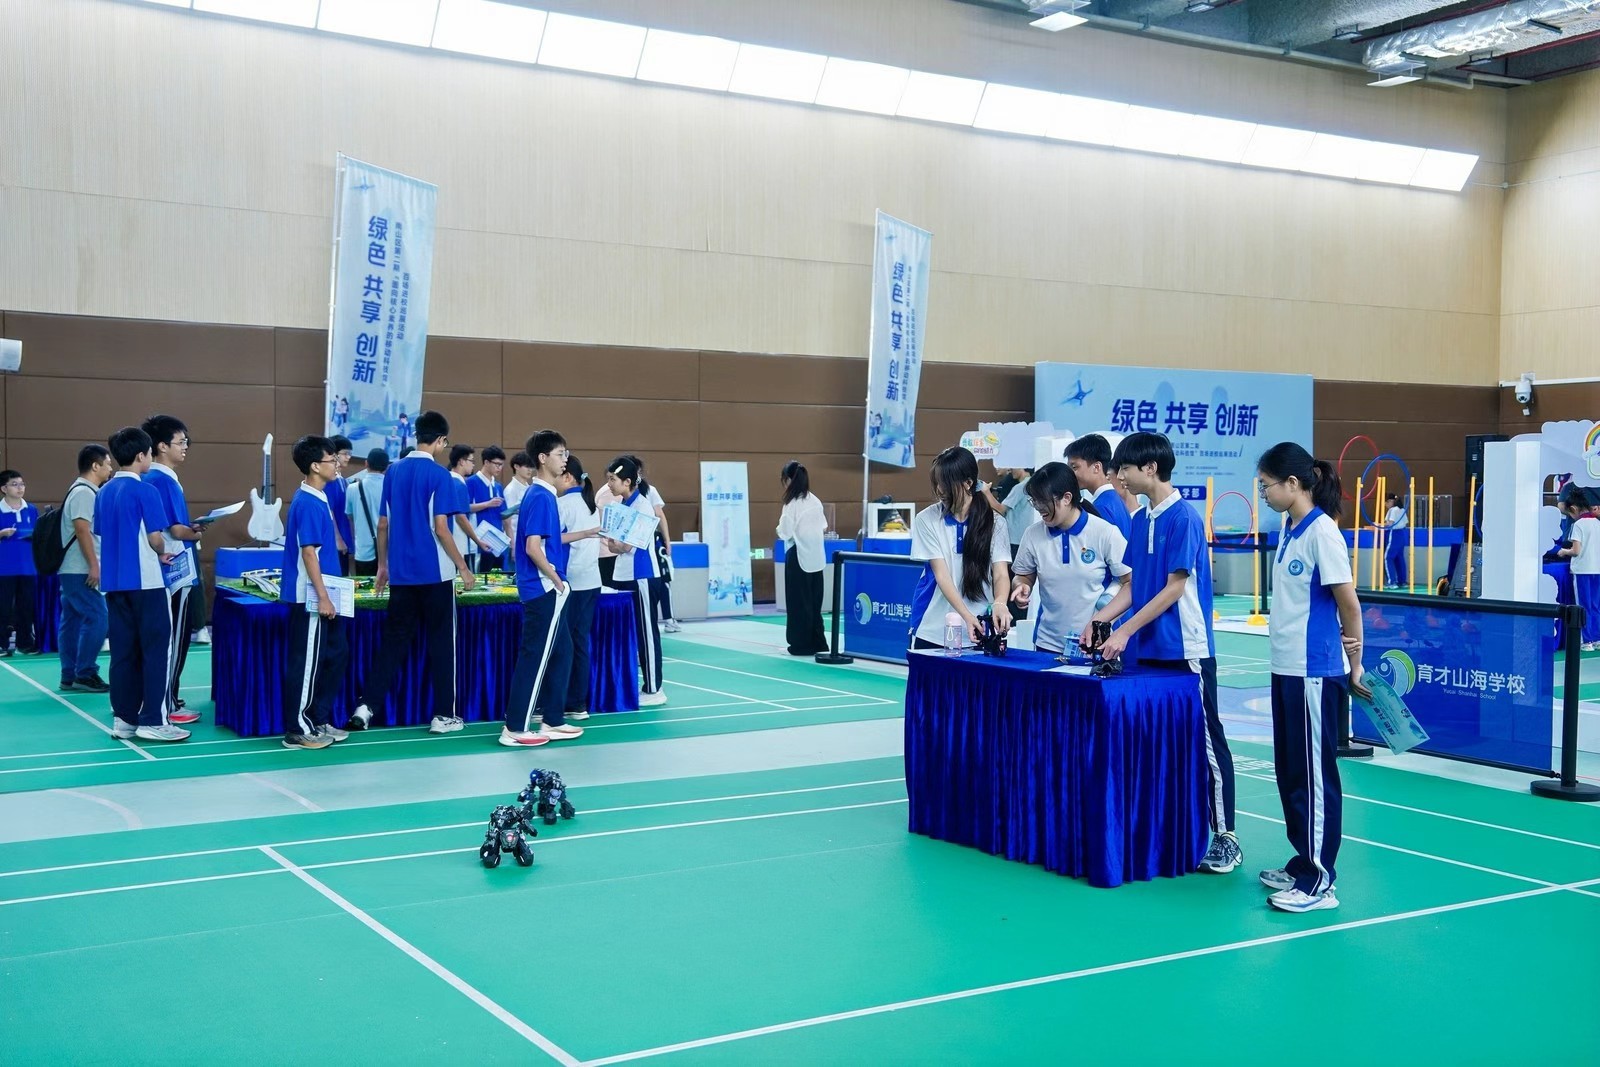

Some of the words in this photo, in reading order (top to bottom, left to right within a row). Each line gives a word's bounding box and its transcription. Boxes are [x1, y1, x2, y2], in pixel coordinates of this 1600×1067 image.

[368, 215, 388, 267] 绿色
[360, 274, 383, 324] 共享
[892, 261, 904, 304] 绿色
[891, 310, 903, 351] 共享
[352, 332, 379, 384] 创新
[886, 359, 899, 401] 创新
[1111, 398, 1158, 433] 绿色
[1164, 401, 1209, 435] 共享
[1215, 403, 1259, 436] 创新
[1180, 488, 1200, 499] 学部
[1417, 664, 1526, 696] 育才山海学校
